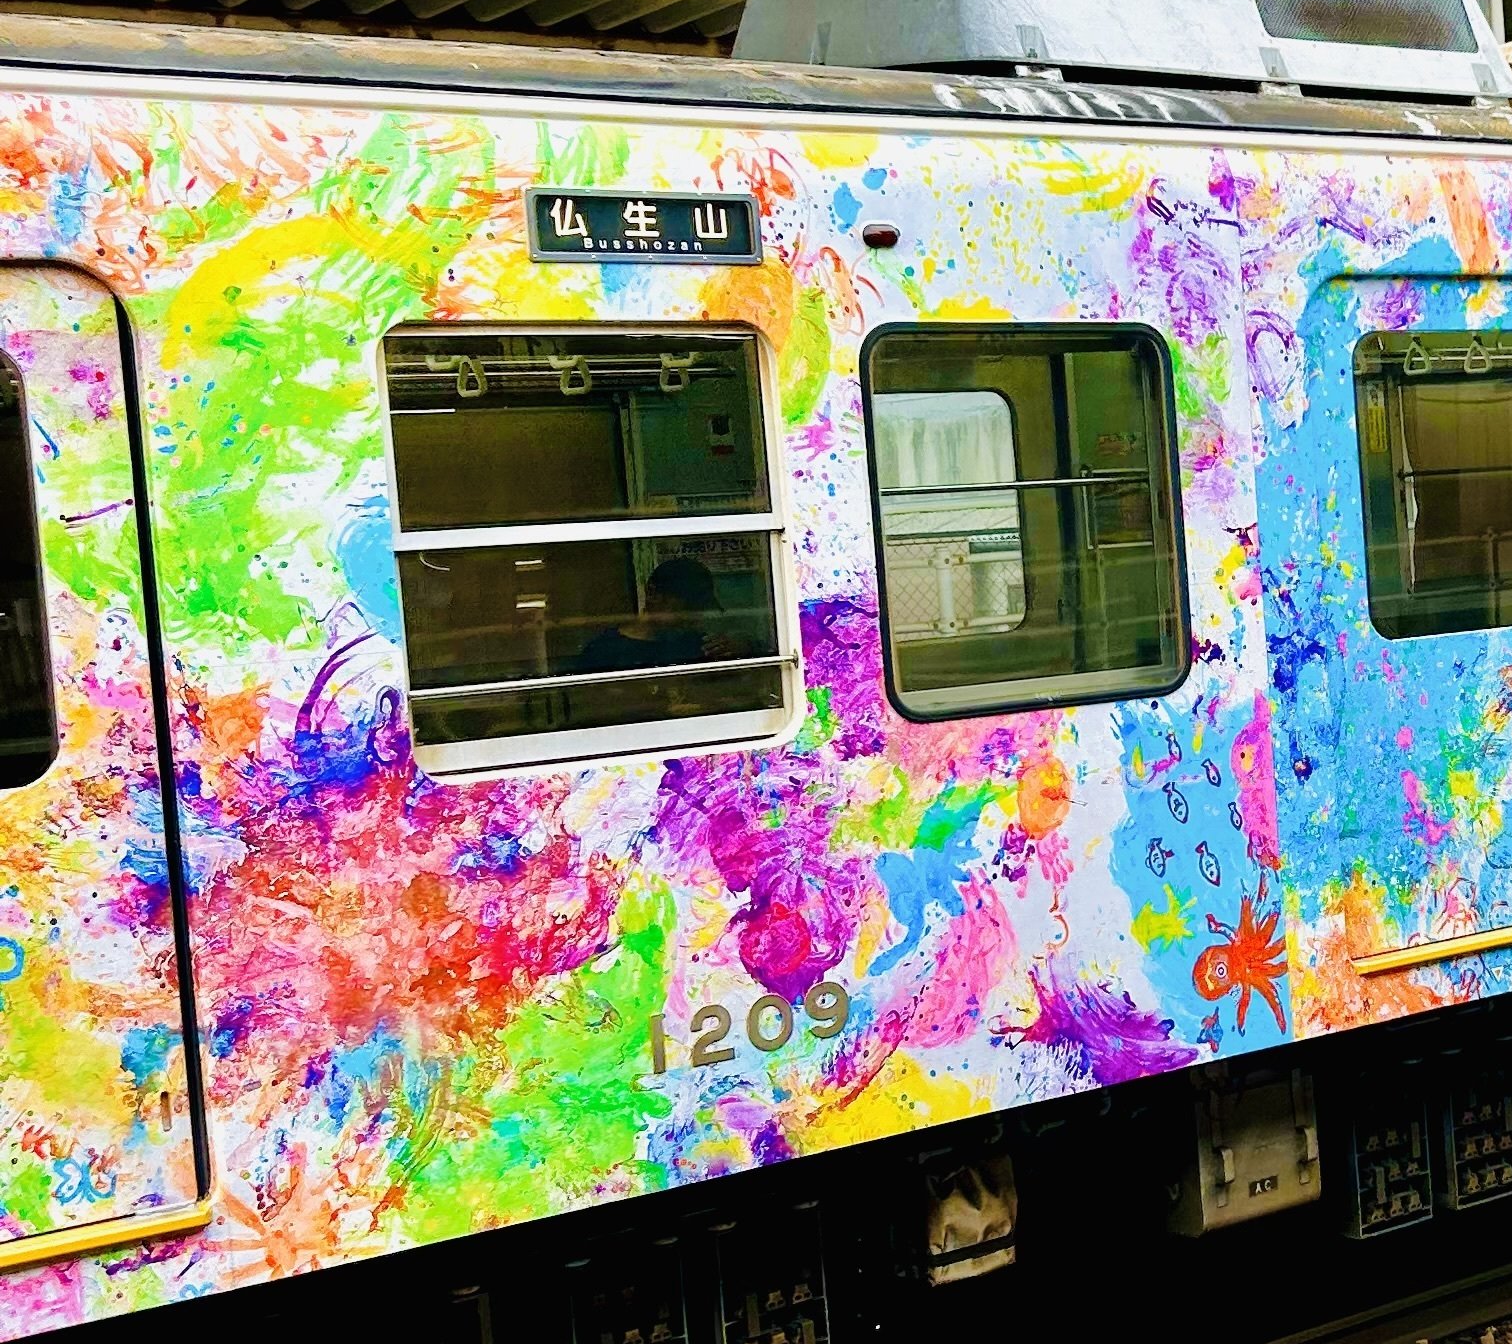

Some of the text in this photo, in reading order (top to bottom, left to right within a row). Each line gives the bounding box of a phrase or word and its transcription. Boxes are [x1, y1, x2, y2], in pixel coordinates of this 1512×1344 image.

[550, 198, 728, 239] 仏生山
[583, 237, 703, 252] Busshozan
[650, 981, 850, 1075] 1209
